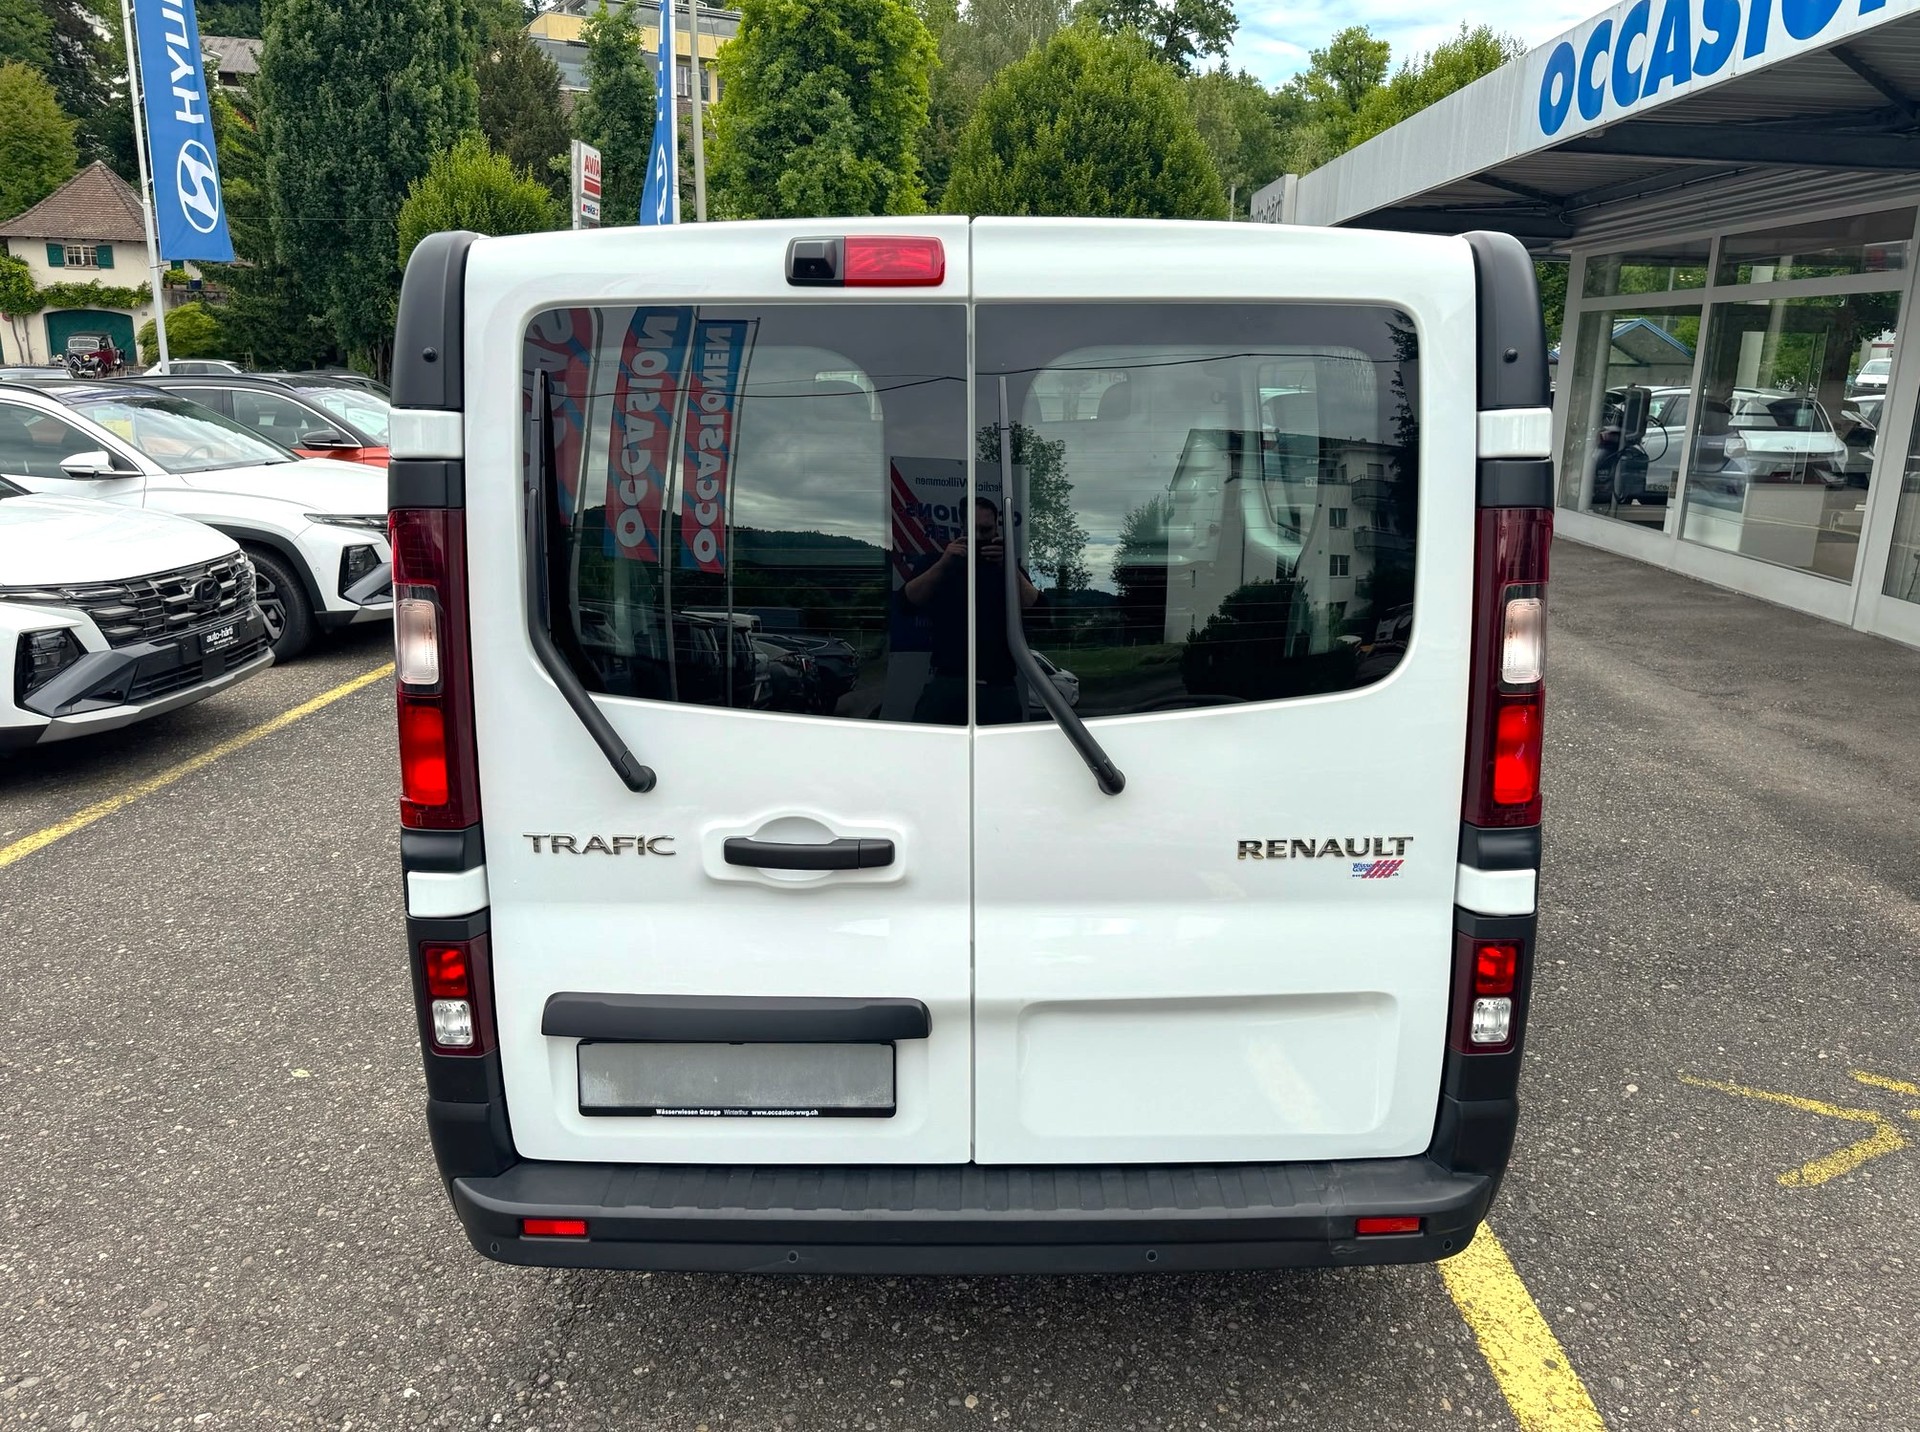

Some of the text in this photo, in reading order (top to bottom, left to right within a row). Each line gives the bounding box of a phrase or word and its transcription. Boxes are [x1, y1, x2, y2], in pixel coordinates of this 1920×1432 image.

[162, 0, 205, 124] HYU
[1539, 0, 1886, 136] OCCASI
[523, 831, 677, 856] TRAFIC
[1237, 836, 1414, 860] RENAULT
[699, 1108, 721, 1117] Garage
[751, 1109, 819, 1117] www.occasion-wwg.ch
